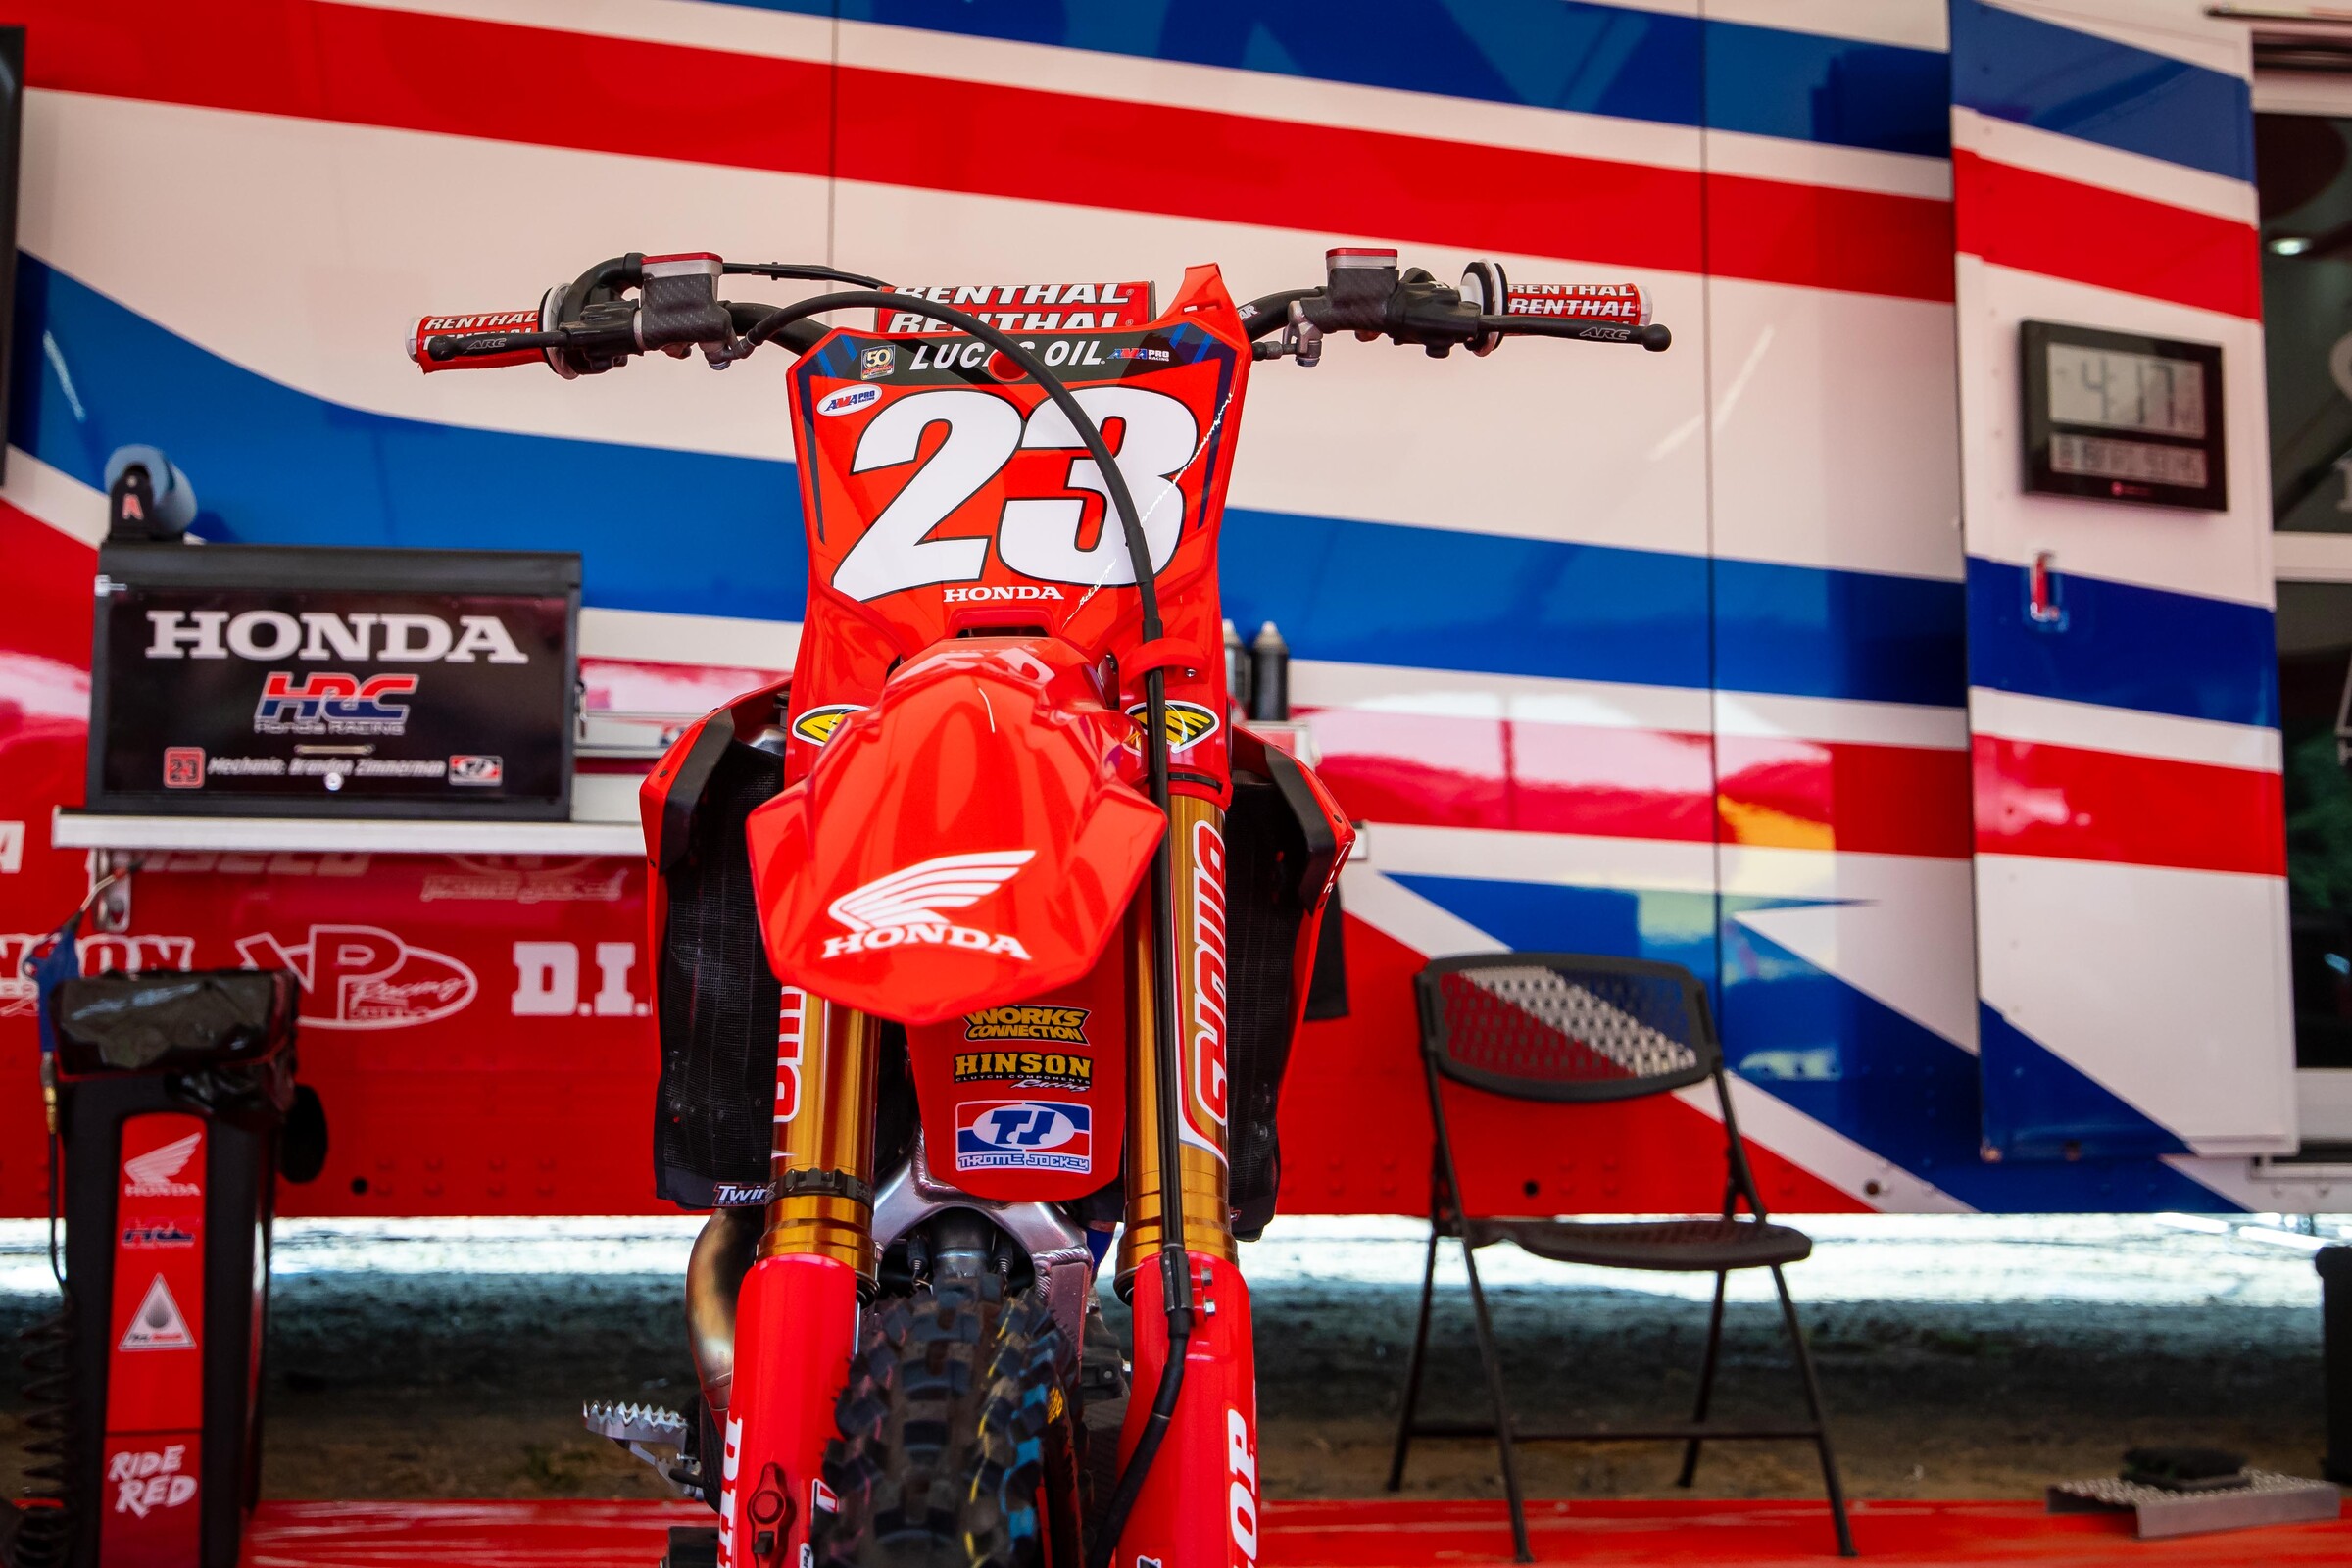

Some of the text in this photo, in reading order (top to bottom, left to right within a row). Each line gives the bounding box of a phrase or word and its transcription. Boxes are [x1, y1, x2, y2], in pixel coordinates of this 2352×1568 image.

[1508, 284, 1635, 297] RENTHAL
[1508, 297, 1637, 317] RENTHAL
[424, 313, 538, 331] RENTHAL
[1580, 327, 1630, 340] ARC
[466, 338, 507, 350] ARC
[1107, 348, 1147, 360] AMA
[865, 348, 892, 368] 50
[909, 340, 1036, 370] LUC
[824, 390, 875, 413] AMA PRO
[831, 388, 1198, 603] 23
[943, 586, 1065, 603] HONDA
[145, 610, 529, 664] HONDA
[254, 671, 419, 722] HRC
[821, 922, 1032, 961] HONDA
[511, 941, 653, 1016] D.I.
[965, 1007, 1085, 1027] WORKS
[967, 1024, 1084, 1042] CONNECTION
[955, 1053, 1092, 1078] HINSON
[1008, 1074, 1091, 1085] COMPONENTS
[990, 1110, 1056, 1145] TJ
[958, 1153, 1090, 1171] THROTTLE JOCKEY
[109, 1444, 187, 1482] RIDE
[115, 1473, 198, 1519] RED
